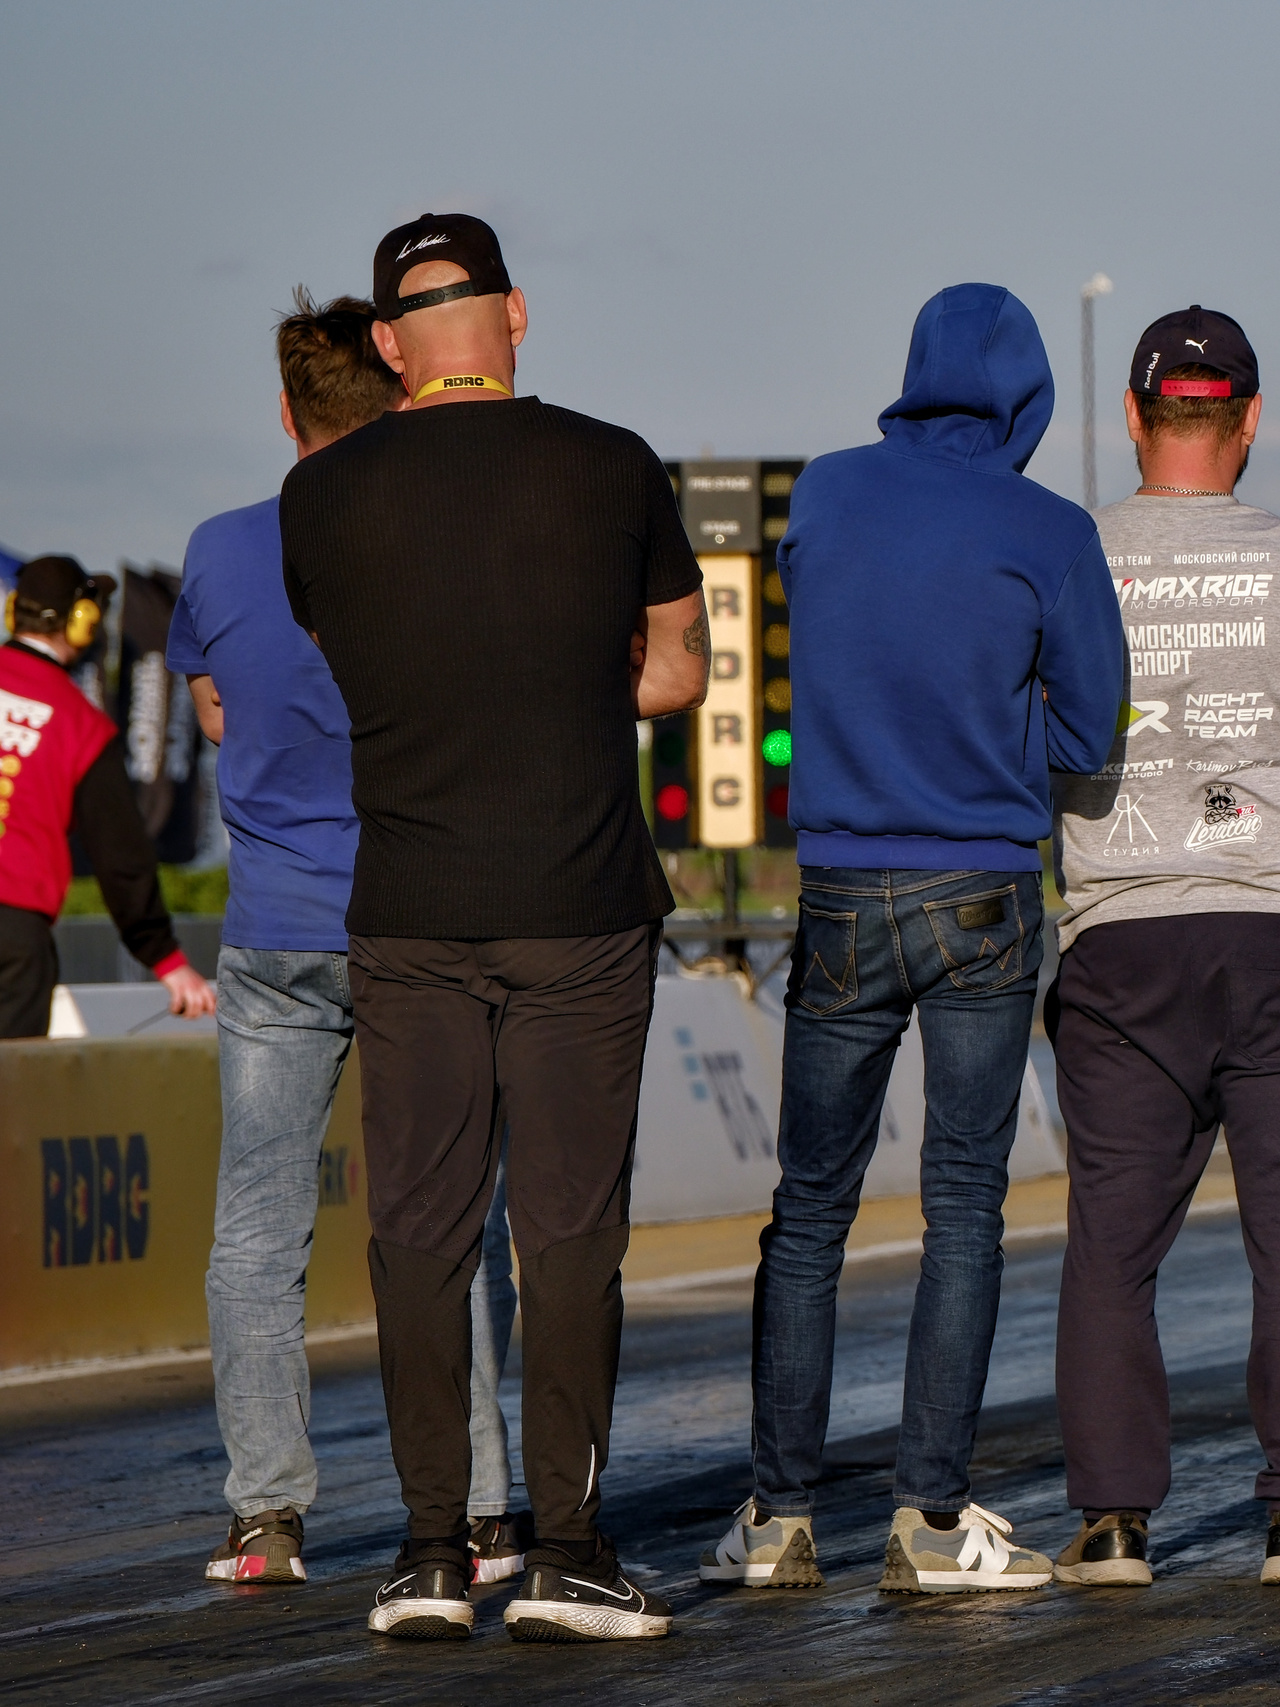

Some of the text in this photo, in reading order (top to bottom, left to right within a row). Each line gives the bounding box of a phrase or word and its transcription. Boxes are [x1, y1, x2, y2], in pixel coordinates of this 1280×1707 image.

[1143, 352, 1161, 389] Red Bull
[443, 376, 485, 389] RDRC
[1107, 555, 1151, 567] CER TEAM
[1174, 552, 1271, 565] МОСКОВСКИЙ СПОРТ
[1132, 576, 1201, 601] MAX
[1130, 597, 1268, 610] MOTORSPORT
[1128, 617, 1266, 650] МОСКОВСКИЙ
[1131, 651, 1192, 677] СПОРТ
[1185, 692, 1265, 707] NIGHT
[1184, 707, 1274, 723] RACER
[1183, 724, 1258, 739] TEAM
[1097, 758, 1174, 775] KOTATI
[1185, 759, 1237, 775] Karimov
[1127, 771, 1164, 780] STUDIO
[1103, 846, 1160, 857] СТУДИЯ
[40, 1132, 150, 1269] RDRC
